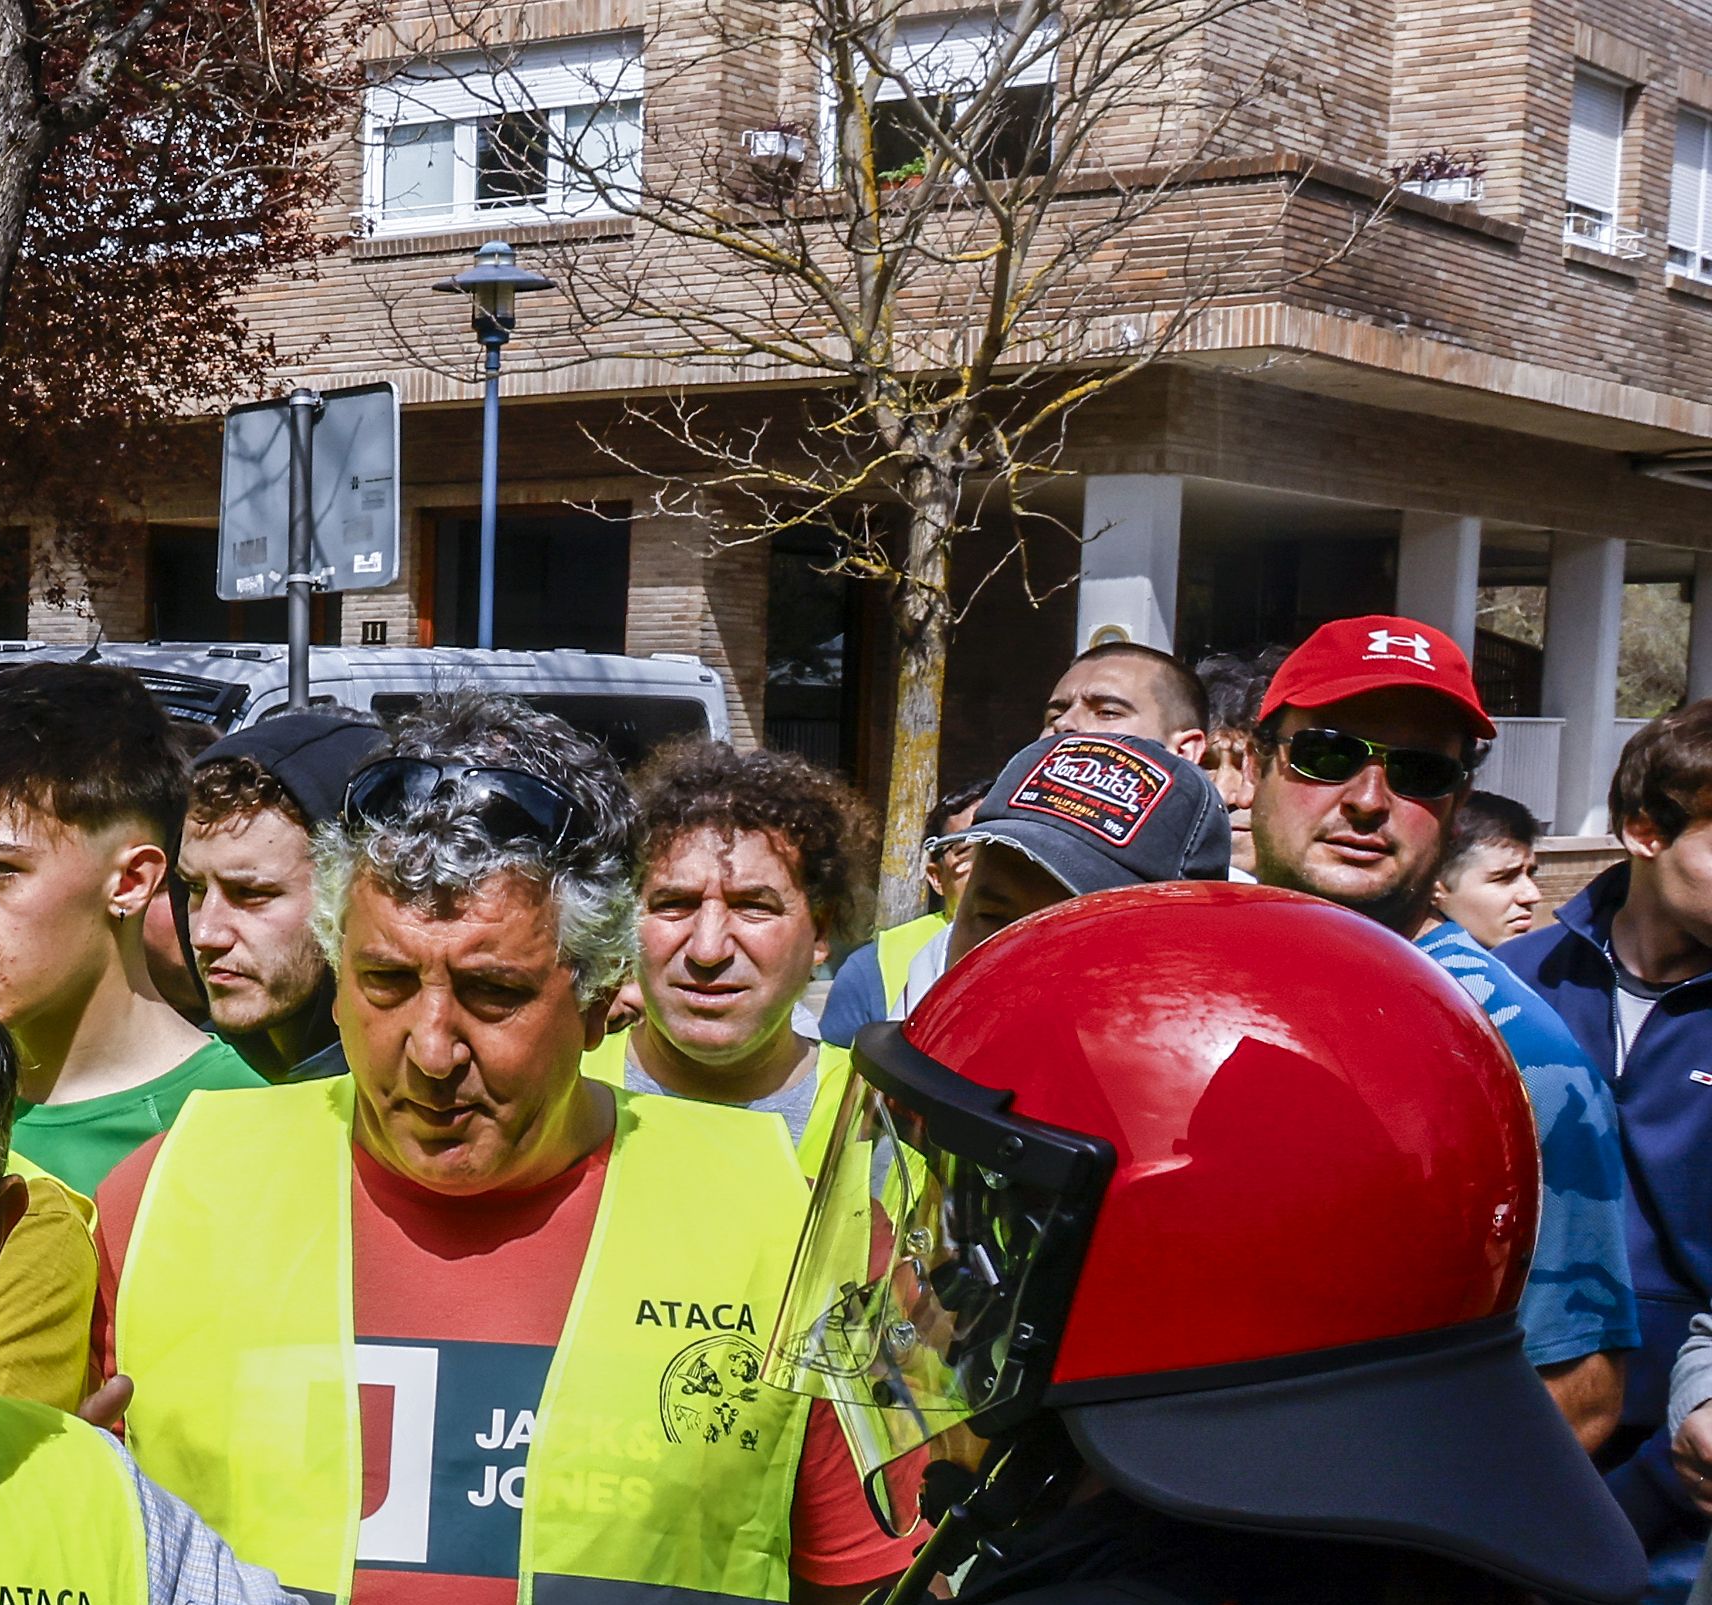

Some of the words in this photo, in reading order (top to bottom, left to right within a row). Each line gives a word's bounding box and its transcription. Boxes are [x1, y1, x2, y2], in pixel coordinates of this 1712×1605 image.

[367, 623, 381, 641] 11
[1103, 818, 1125, 837] 1992
[635, 1299, 757, 1335] ATACA
